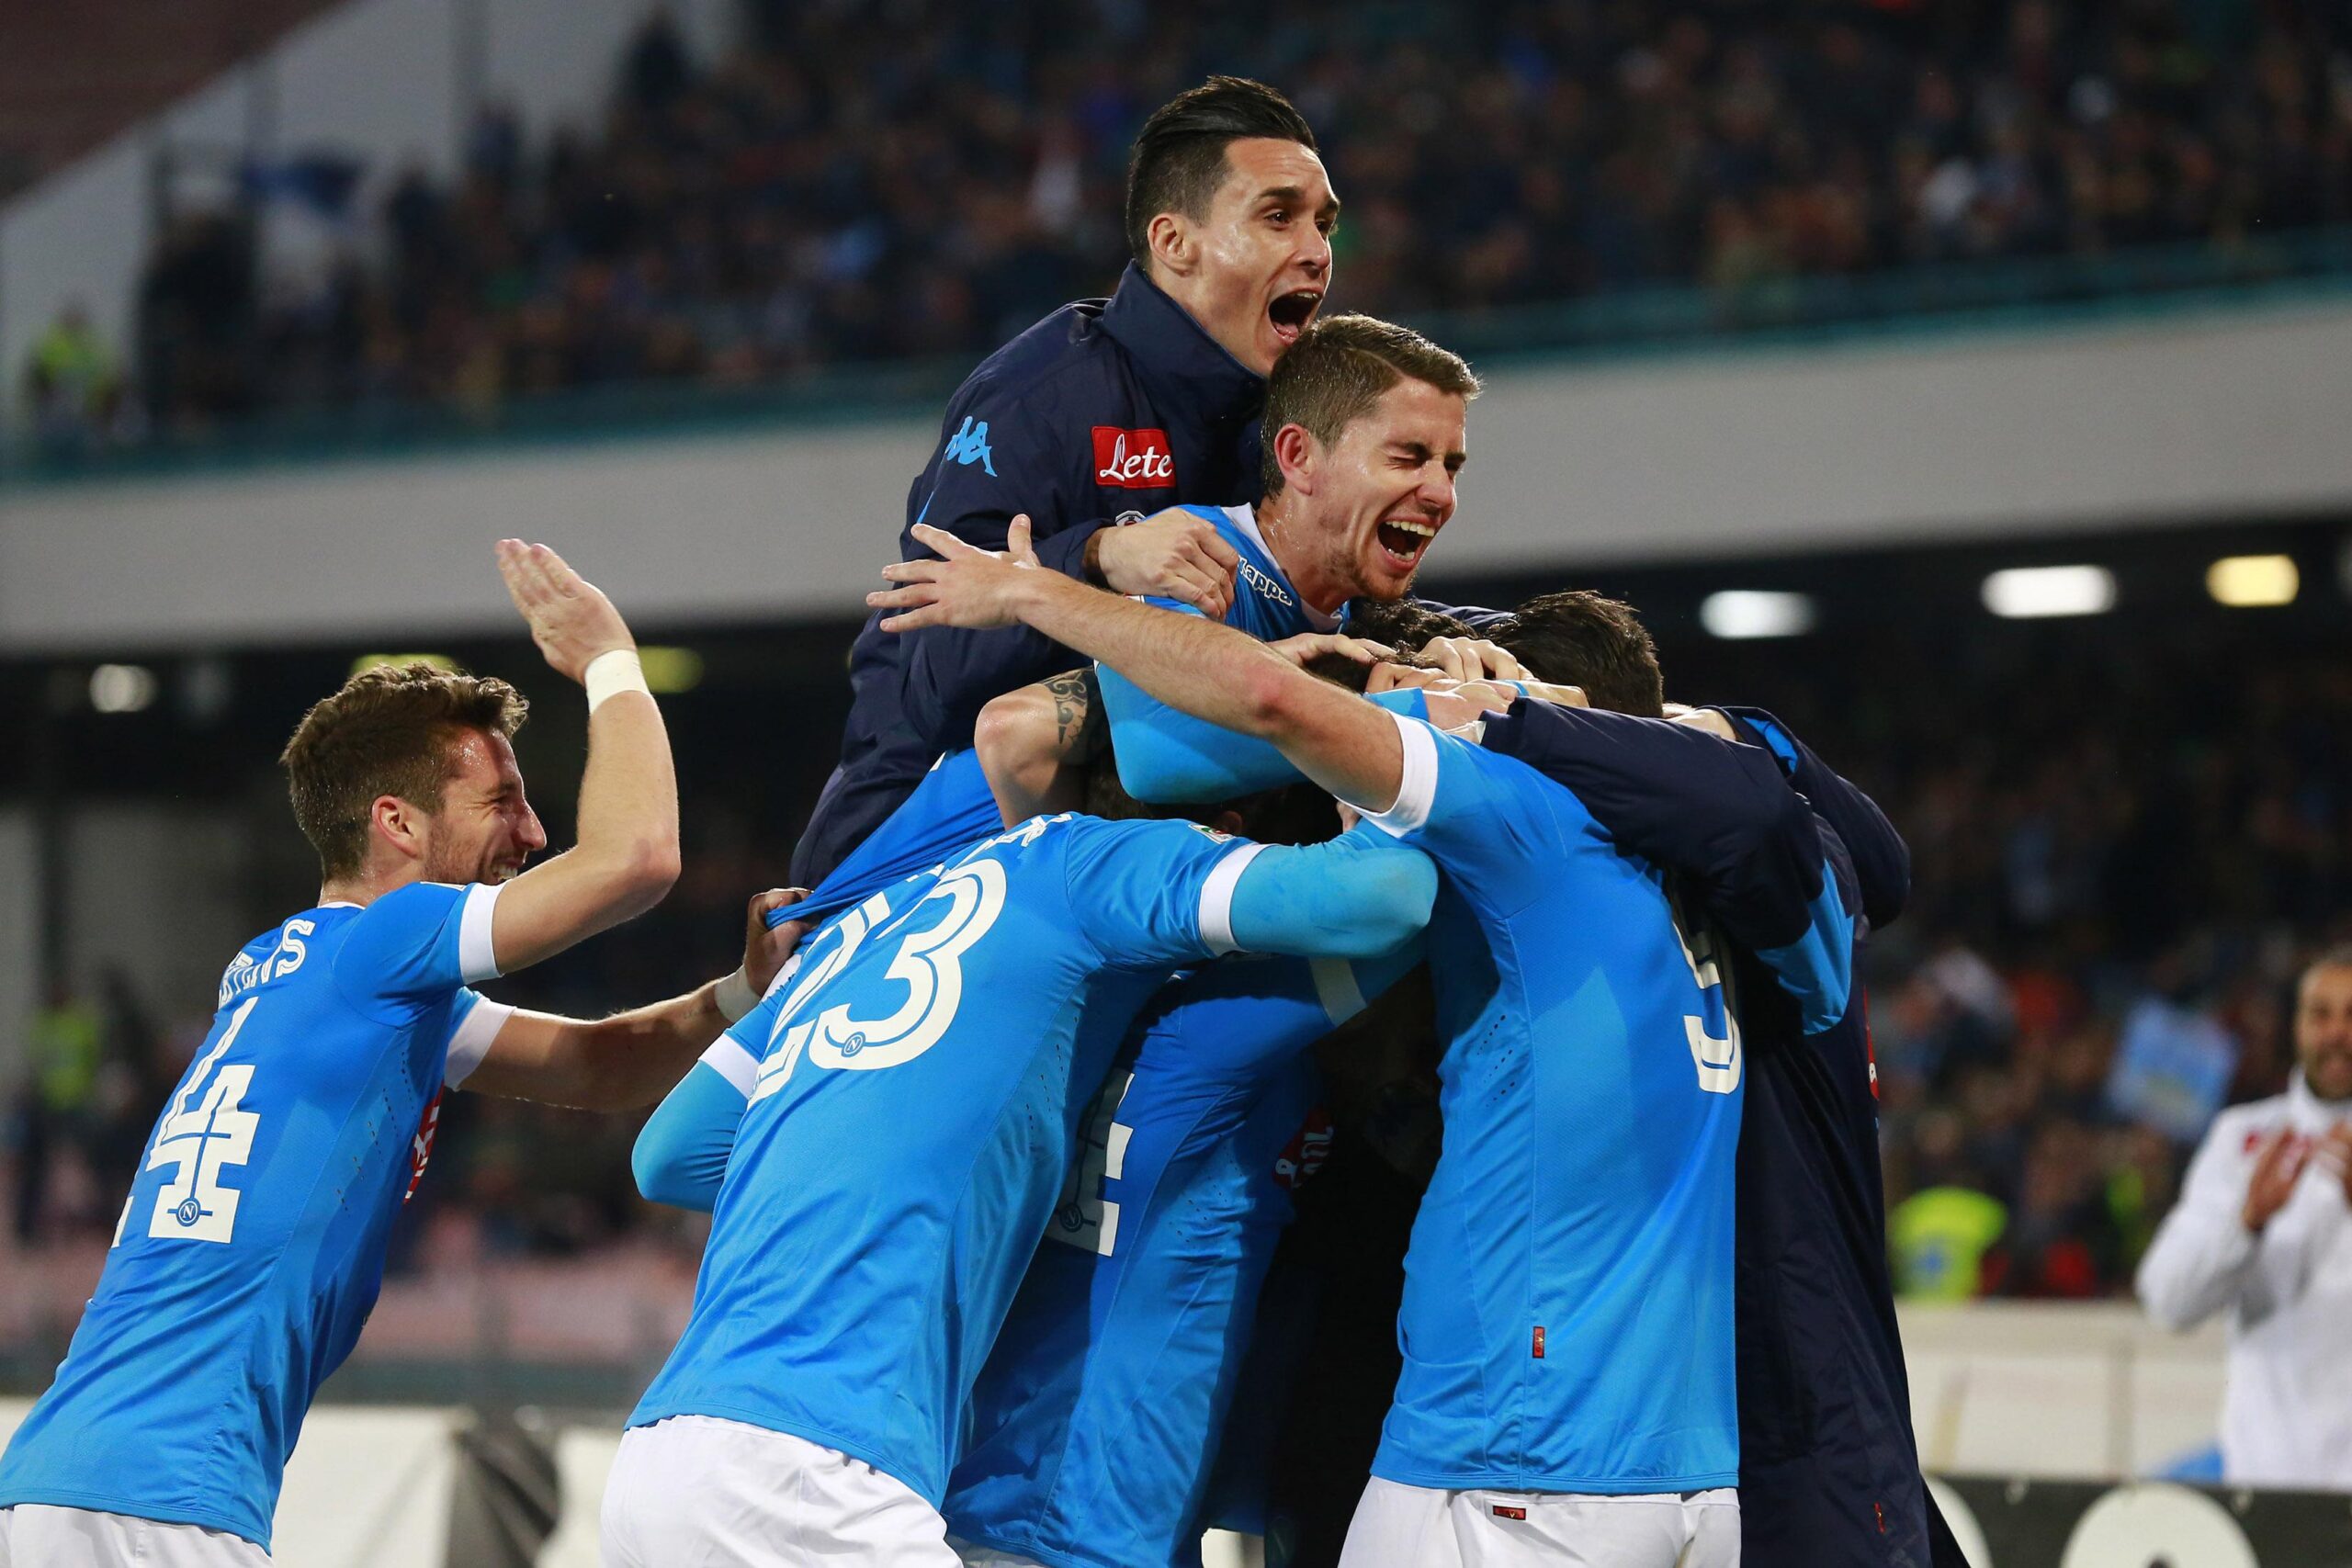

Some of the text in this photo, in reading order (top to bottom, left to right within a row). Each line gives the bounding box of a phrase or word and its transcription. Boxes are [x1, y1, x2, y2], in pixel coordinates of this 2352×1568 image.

[1099, 433, 1172, 482] Lete
[746, 858, 1007, 1111] 23
[110, 996, 261, 1247] 4
